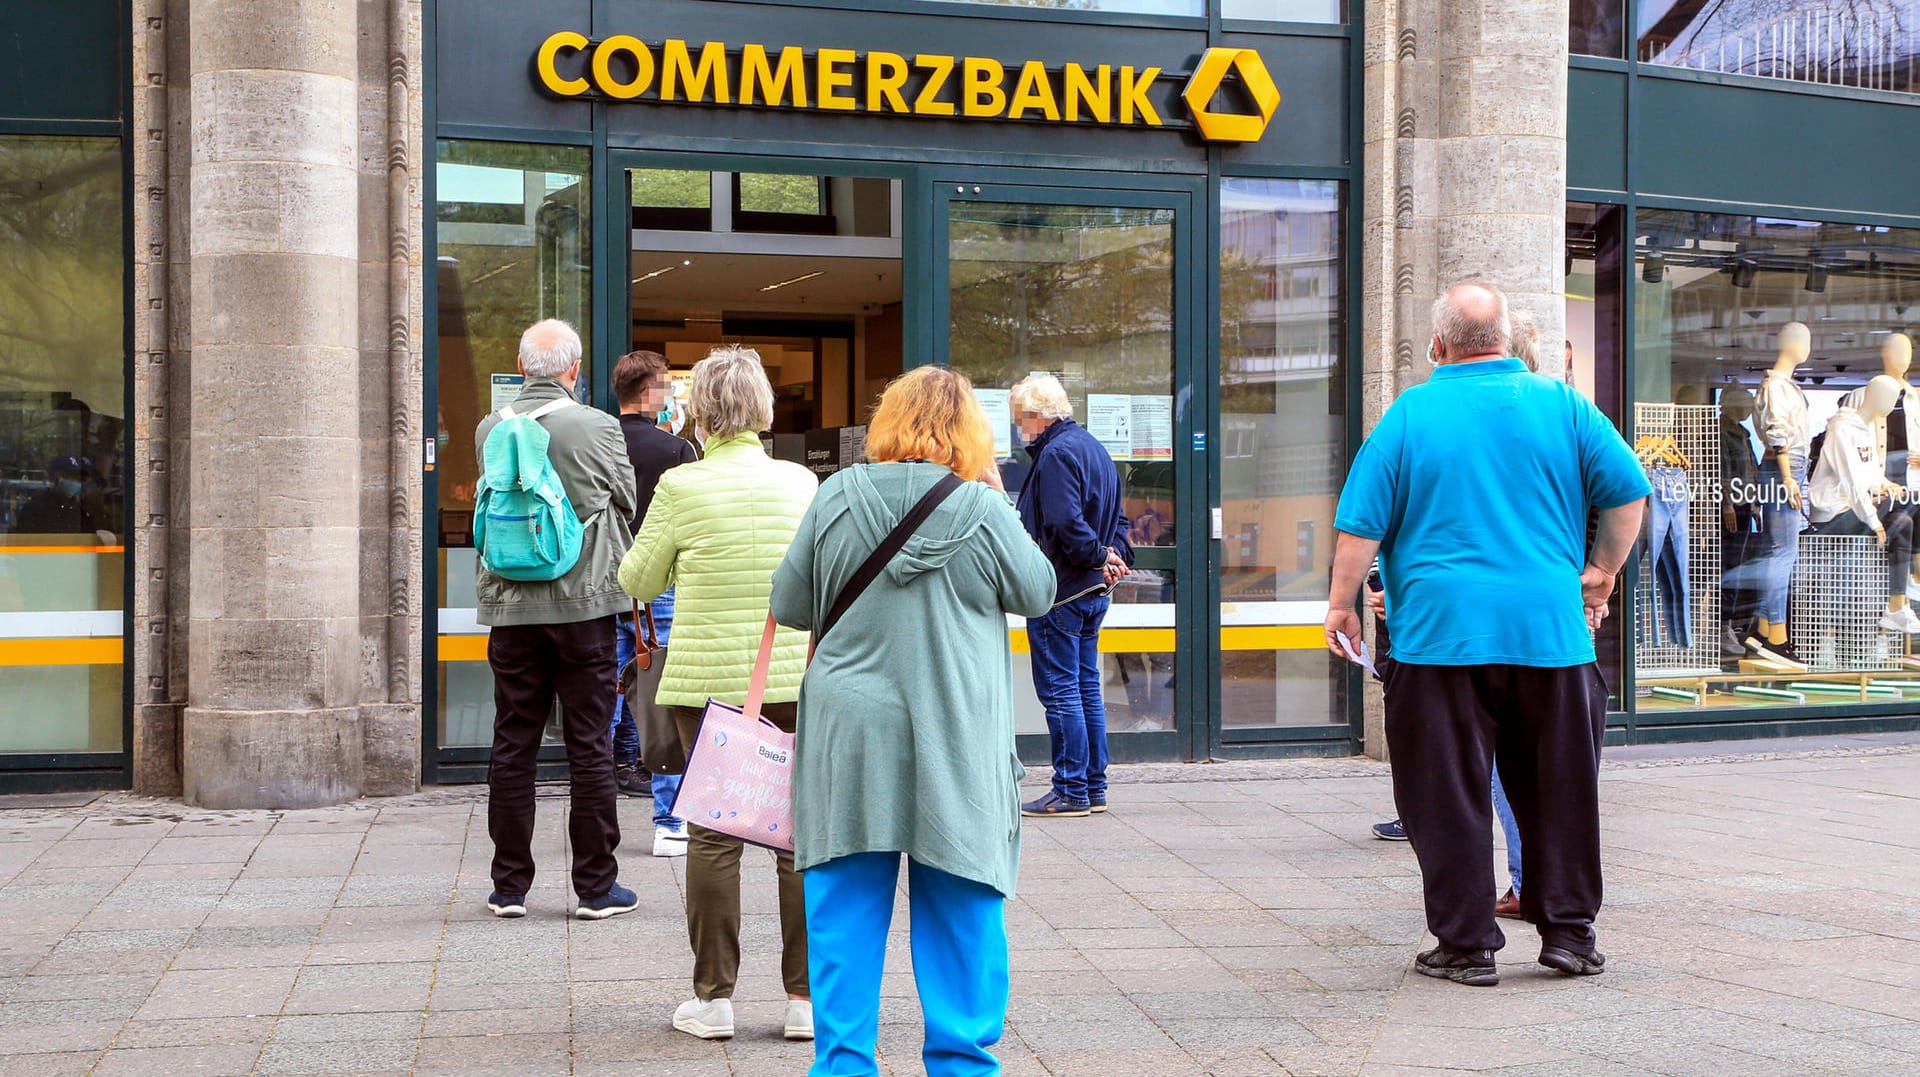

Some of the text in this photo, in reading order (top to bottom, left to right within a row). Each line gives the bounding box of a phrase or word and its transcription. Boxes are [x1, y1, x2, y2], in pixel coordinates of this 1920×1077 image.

[537, 31, 1163, 126] COMMERZBANK
[1660, 477, 1723, 503] Levi's
[758, 745, 787, 764] Balea
[722, 778, 792, 819] gepfleg
